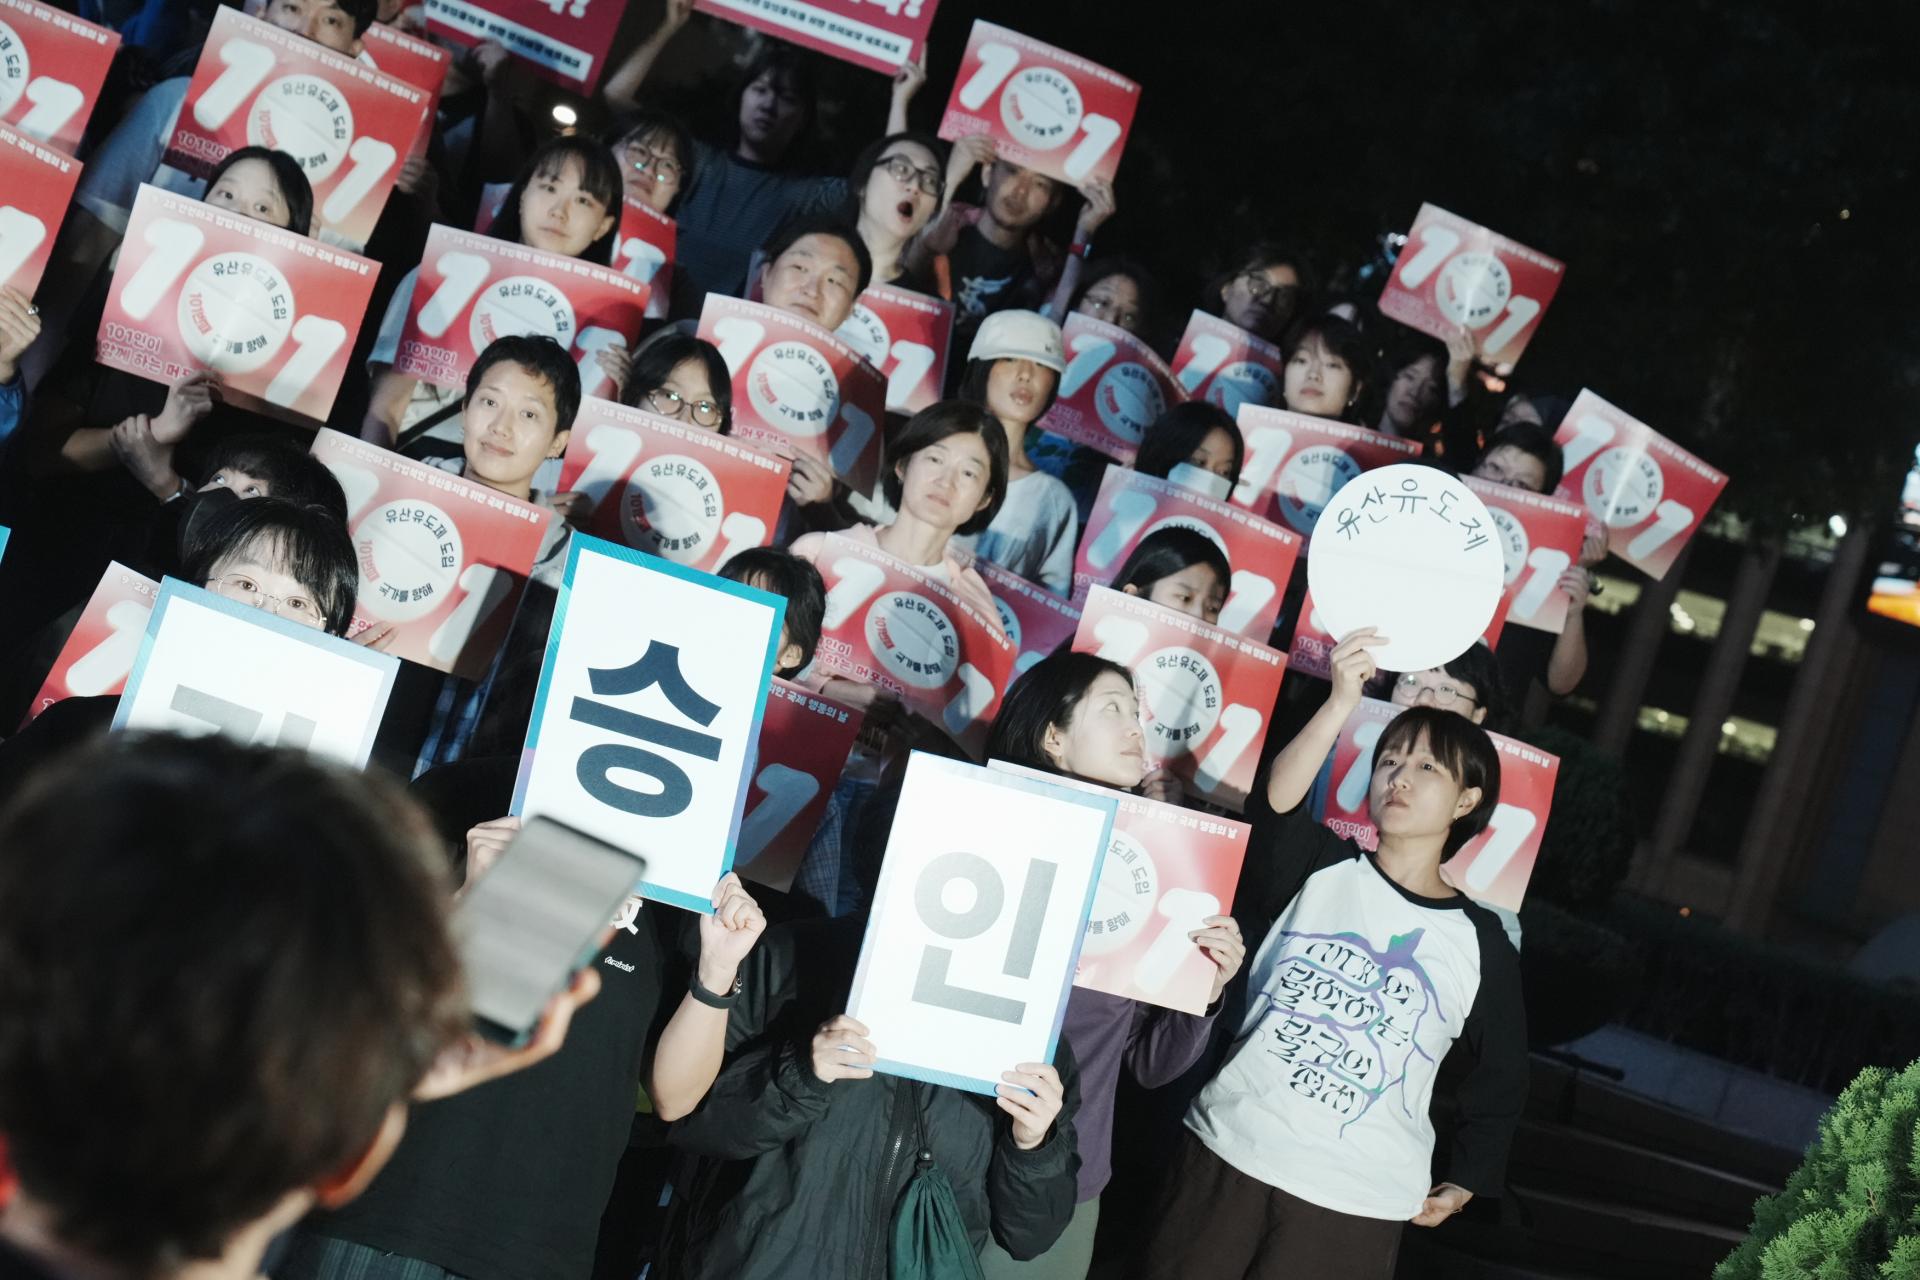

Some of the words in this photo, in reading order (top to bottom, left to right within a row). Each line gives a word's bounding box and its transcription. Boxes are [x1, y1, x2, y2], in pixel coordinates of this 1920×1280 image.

[283, 82, 339, 113] 유산유도제
[332, 115, 345, 139] 도입
[213, 262, 277, 292] 유산유도제
[271, 293, 287, 320] 도입
[499, 284, 558, 309] 유산유도제
[553, 309, 569, 333] 도입
[245, 335, 268, 352] 향해
[774, 348, 827, 375] 유산유도제
[651, 463, 707, 492] 유산유도제
[702, 492, 716, 518] 도입
[1336, 478, 1489, 552] 유산유도제
[386, 508, 447, 540] 유산유도제
[440, 541, 454, 569] 도입
[377, 581, 408, 603] 국가를
[411, 584, 434, 601] 향해
[893, 596, 946, 631] 유산유도제
[1156, 655, 1208, 683] 유산유도제
[1203, 684, 1215, 709] 도입
[569, 639, 723, 818] 승
[787, 690, 808, 706] 국제
[808, 699, 837, 718] 행동의
[837, 710, 849, 724] 날
[1154, 722, 1180, 740] 국가를
[1182, 722, 1200, 738] 향해
[1199, 820, 1227, 836] 행동의
[1328, 818, 1372, 841] 101인이
[1131, 866, 1150, 895] 도입
[911, 851, 1058, 1026] 인
[1106, 912, 1131, 932] 향해
[1266, 1015, 1372, 1080] 불구의
[1289, 1063, 1356, 1115] 정치
